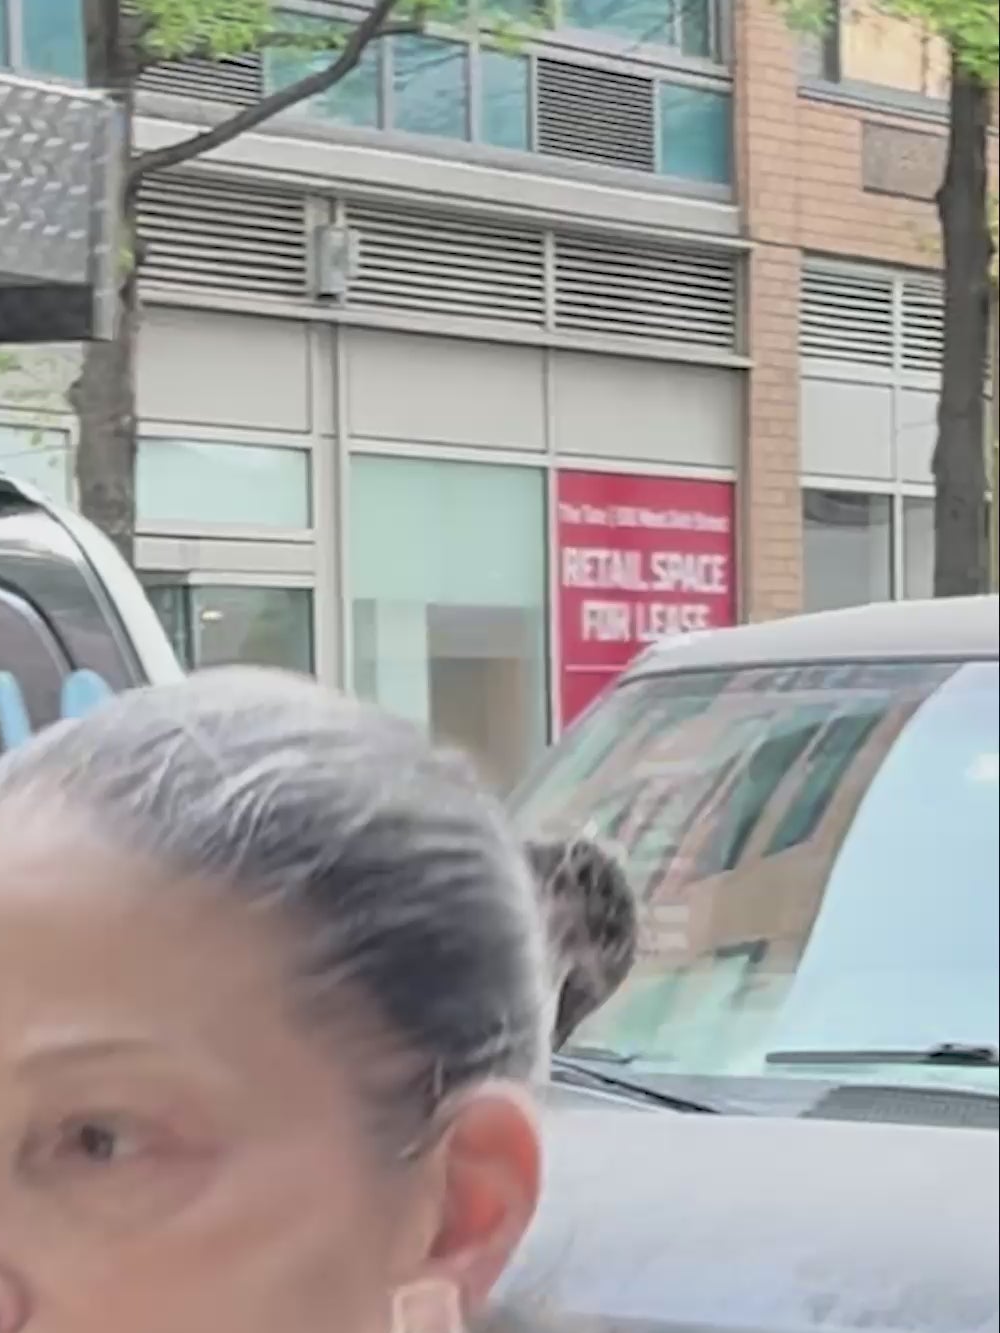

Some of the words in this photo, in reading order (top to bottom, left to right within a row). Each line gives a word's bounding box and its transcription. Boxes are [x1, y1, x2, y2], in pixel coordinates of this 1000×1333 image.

[562, 547, 648, 591] RETAIL
[651, 552, 728, 595] SPACE
[581, 600, 630, 643] FOR
